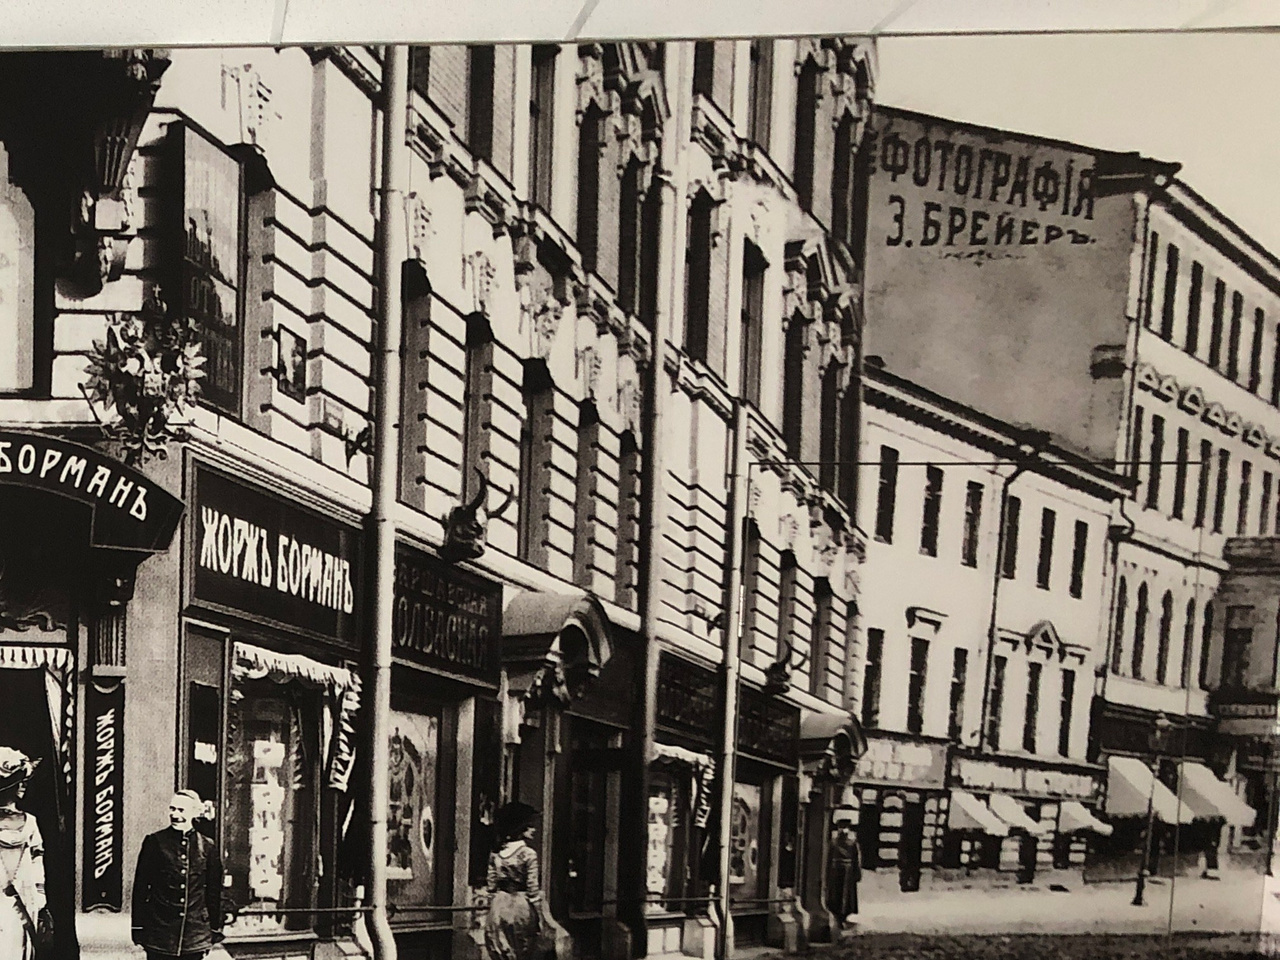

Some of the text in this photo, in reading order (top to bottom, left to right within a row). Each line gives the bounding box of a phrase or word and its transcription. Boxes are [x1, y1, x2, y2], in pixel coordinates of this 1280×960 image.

[199, 505, 354, 614] ЖОРЖЪ БОРМАНЪ
[94, 708, 116, 879] ЖОРЖЪ БОРМАНЪ
